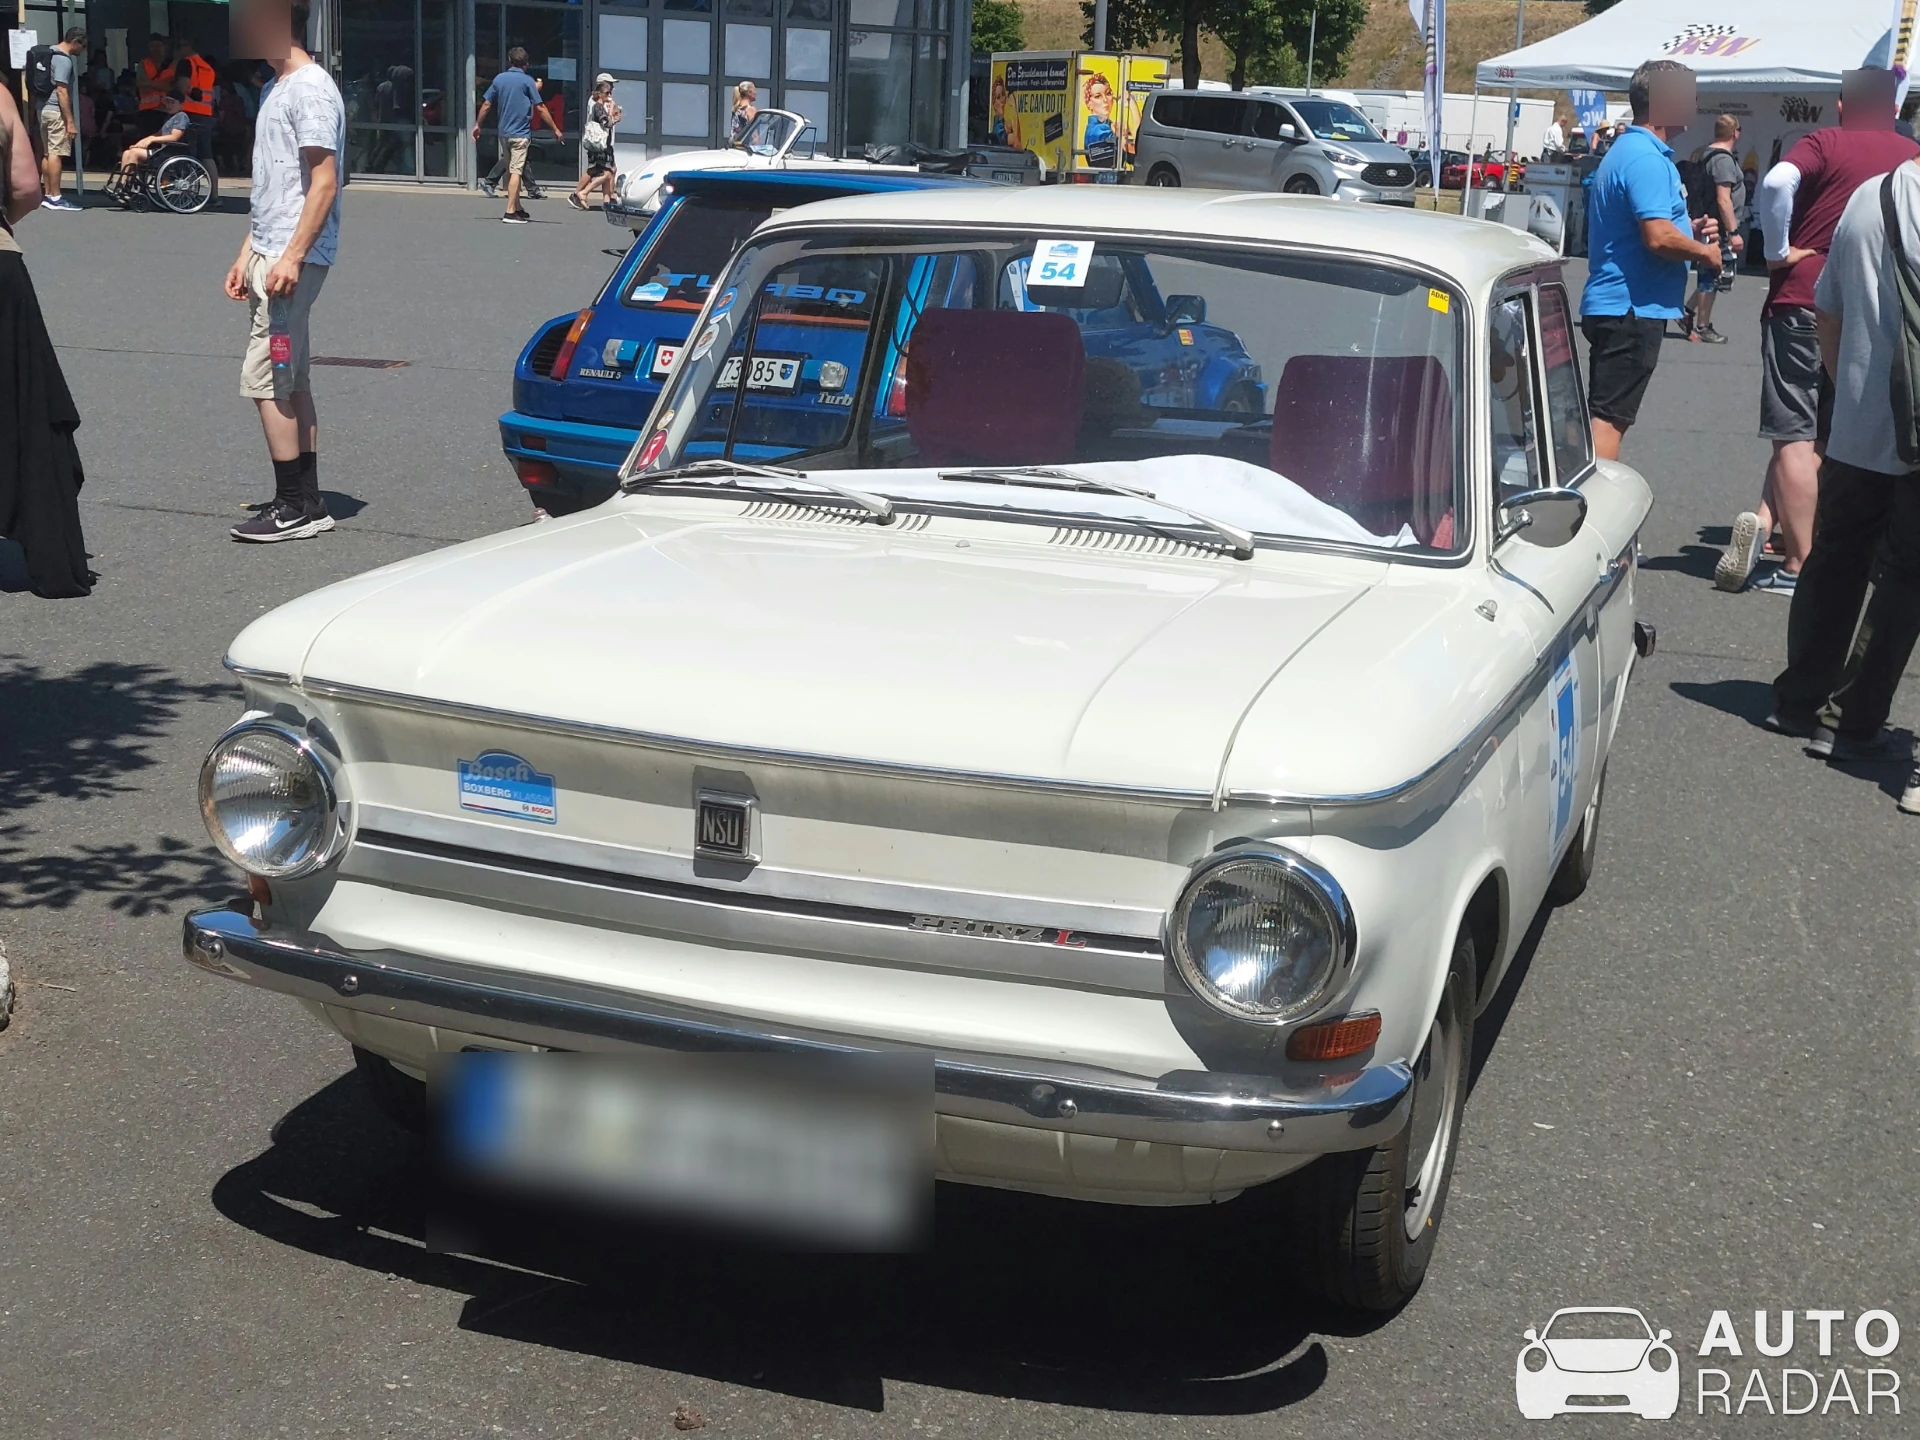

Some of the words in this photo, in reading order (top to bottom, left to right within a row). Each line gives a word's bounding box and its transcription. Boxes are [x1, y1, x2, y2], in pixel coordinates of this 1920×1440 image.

[1017, 93, 1028, 113] WE
[1029, 93, 1045, 113] CAN
[1046, 93, 1057, 113] DO
[1057, 93, 1067, 113] IT!
[1040, 262, 1076, 280] 54
[1431, 290, 1449, 302] ADAC
[579, 368, 615, 378] RENAULT
[615, 371, 621, 379] 5
[463, 782, 512, 798] BOXBERG
[513, 790, 552, 804] KLASSIK
[531, 806, 552, 815] BOSCH
[702, 807, 740, 846] NSU
[908, 914, 1046, 943] PRINZ
[1053, 929, 1087, 949] L
